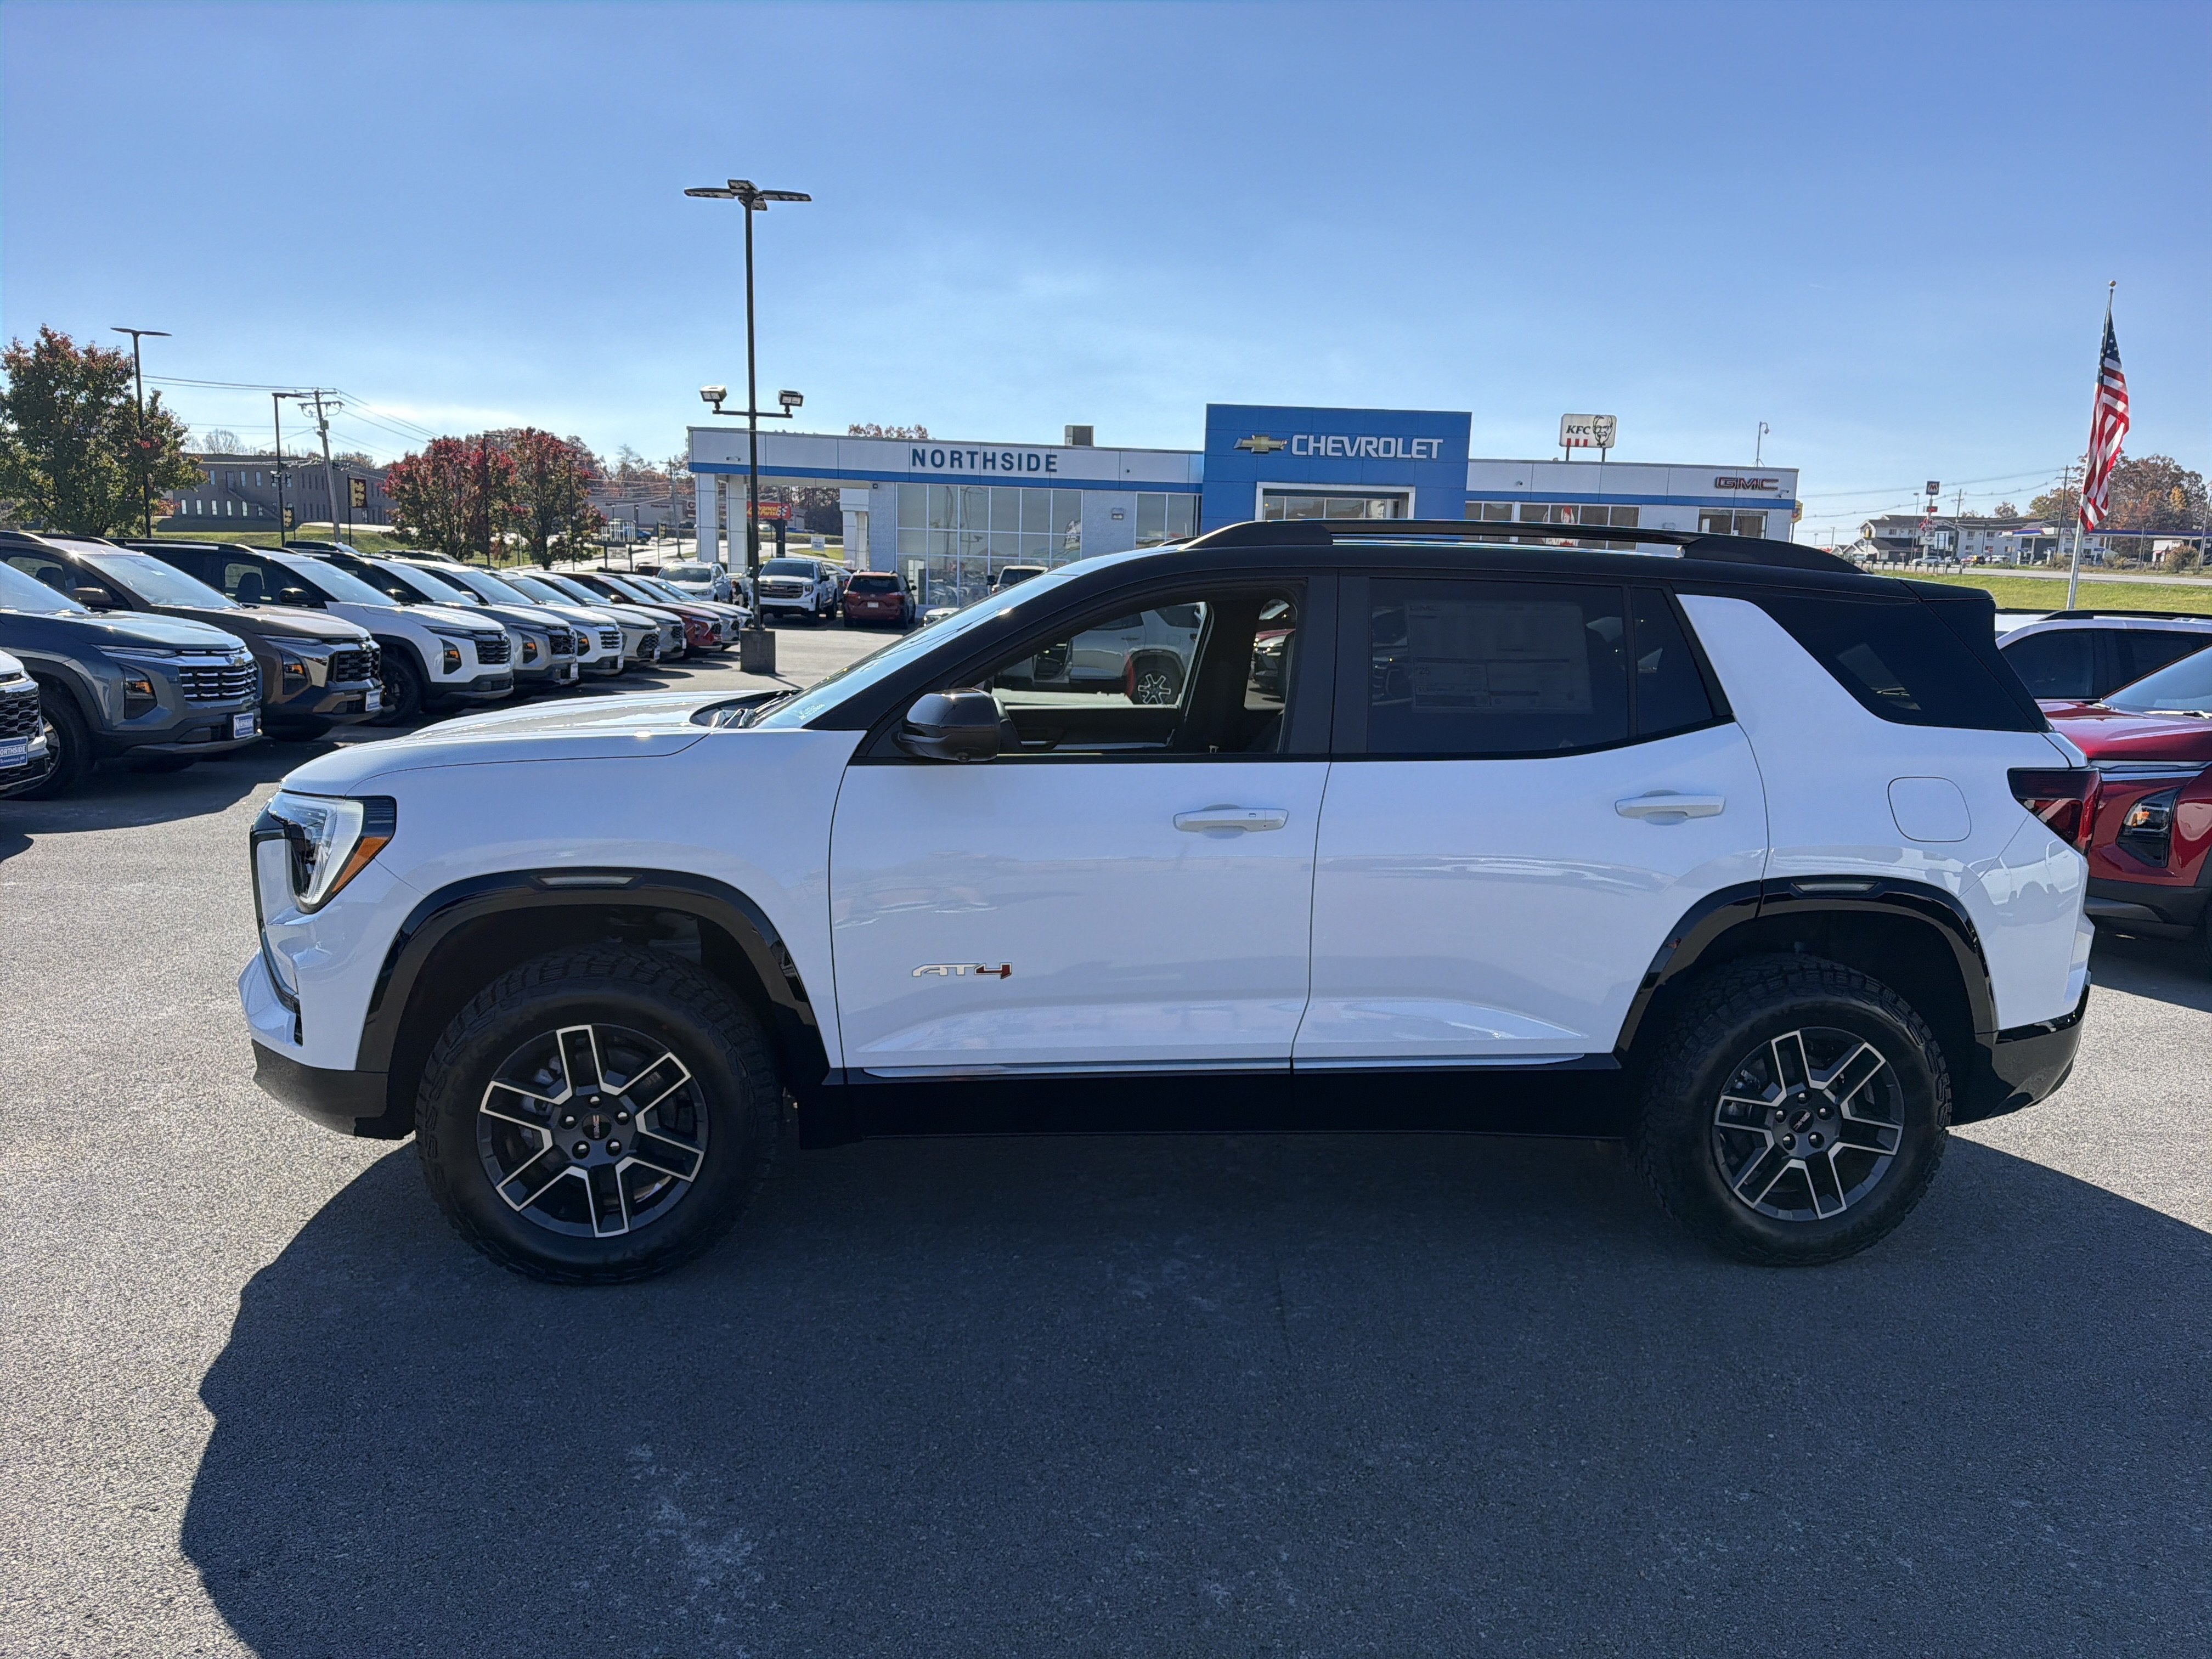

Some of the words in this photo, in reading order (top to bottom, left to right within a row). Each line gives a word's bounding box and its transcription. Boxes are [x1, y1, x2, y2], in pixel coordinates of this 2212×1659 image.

[1566, 425, 1591, 435] KFC
[1291, 435, 1443, 459] CHEVROLET
[912, 448, 1058, 472] NORTHSIDE
[1716, 476, 1779, 491] GMC
[0, 745, 26, 755] ORTHSIDE
[912, 963, 1012, 979] AT4
